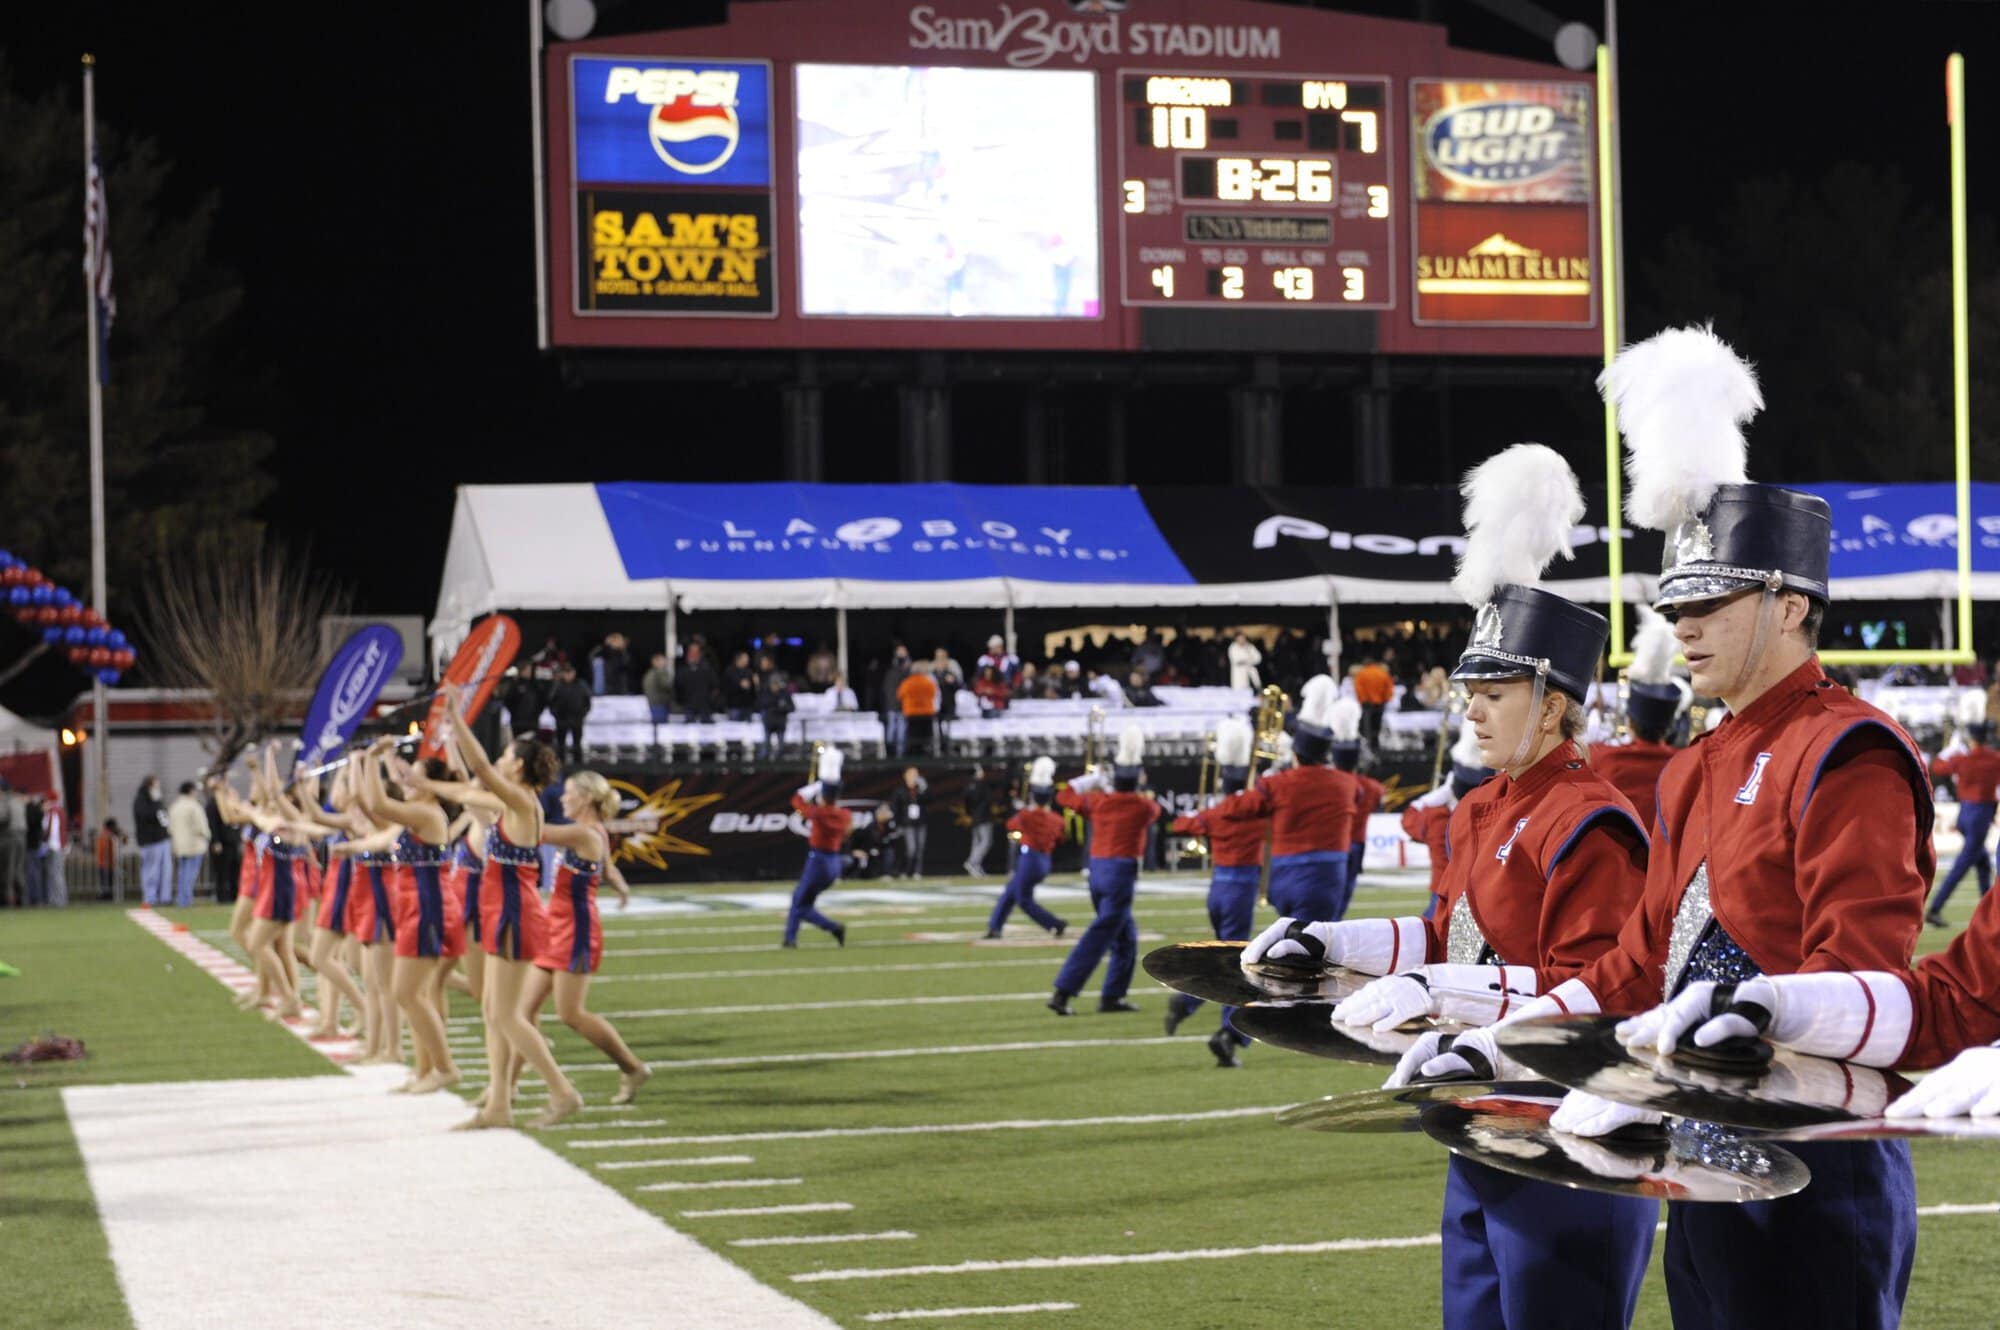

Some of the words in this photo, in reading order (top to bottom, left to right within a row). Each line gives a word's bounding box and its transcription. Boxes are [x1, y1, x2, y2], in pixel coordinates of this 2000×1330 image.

[908, 6, 996, 52] Sam
[988, 5, 1121, 67] Boyd
[1129, 24, 1281, 58] STADIUM
[604, 66, 740, 106] PEPSI
[1152, 105, 1207, 149] 10
[1340, 110, 1378, 153] 7
[1450, 105, 1556, 139] BUD
[1436, 130, 1568, 167] LIGHT
[1122, 179, 1146, 214] 3
[1216, 158, 1333, 202] 8:26
[1366, 185, 1390, 219] 3
[593, 210, 760, 248] SAM'S
[594, 247, 766, 282] TOWN
[1151, 265, 1174, 298] 4
[1416, 254, 1591, 280] SUMMERLIN
[1221, 266, 1245, 299] 2
[1273, 267, 1314, 301] 43
[1342, 267, 1365, 301] 3
